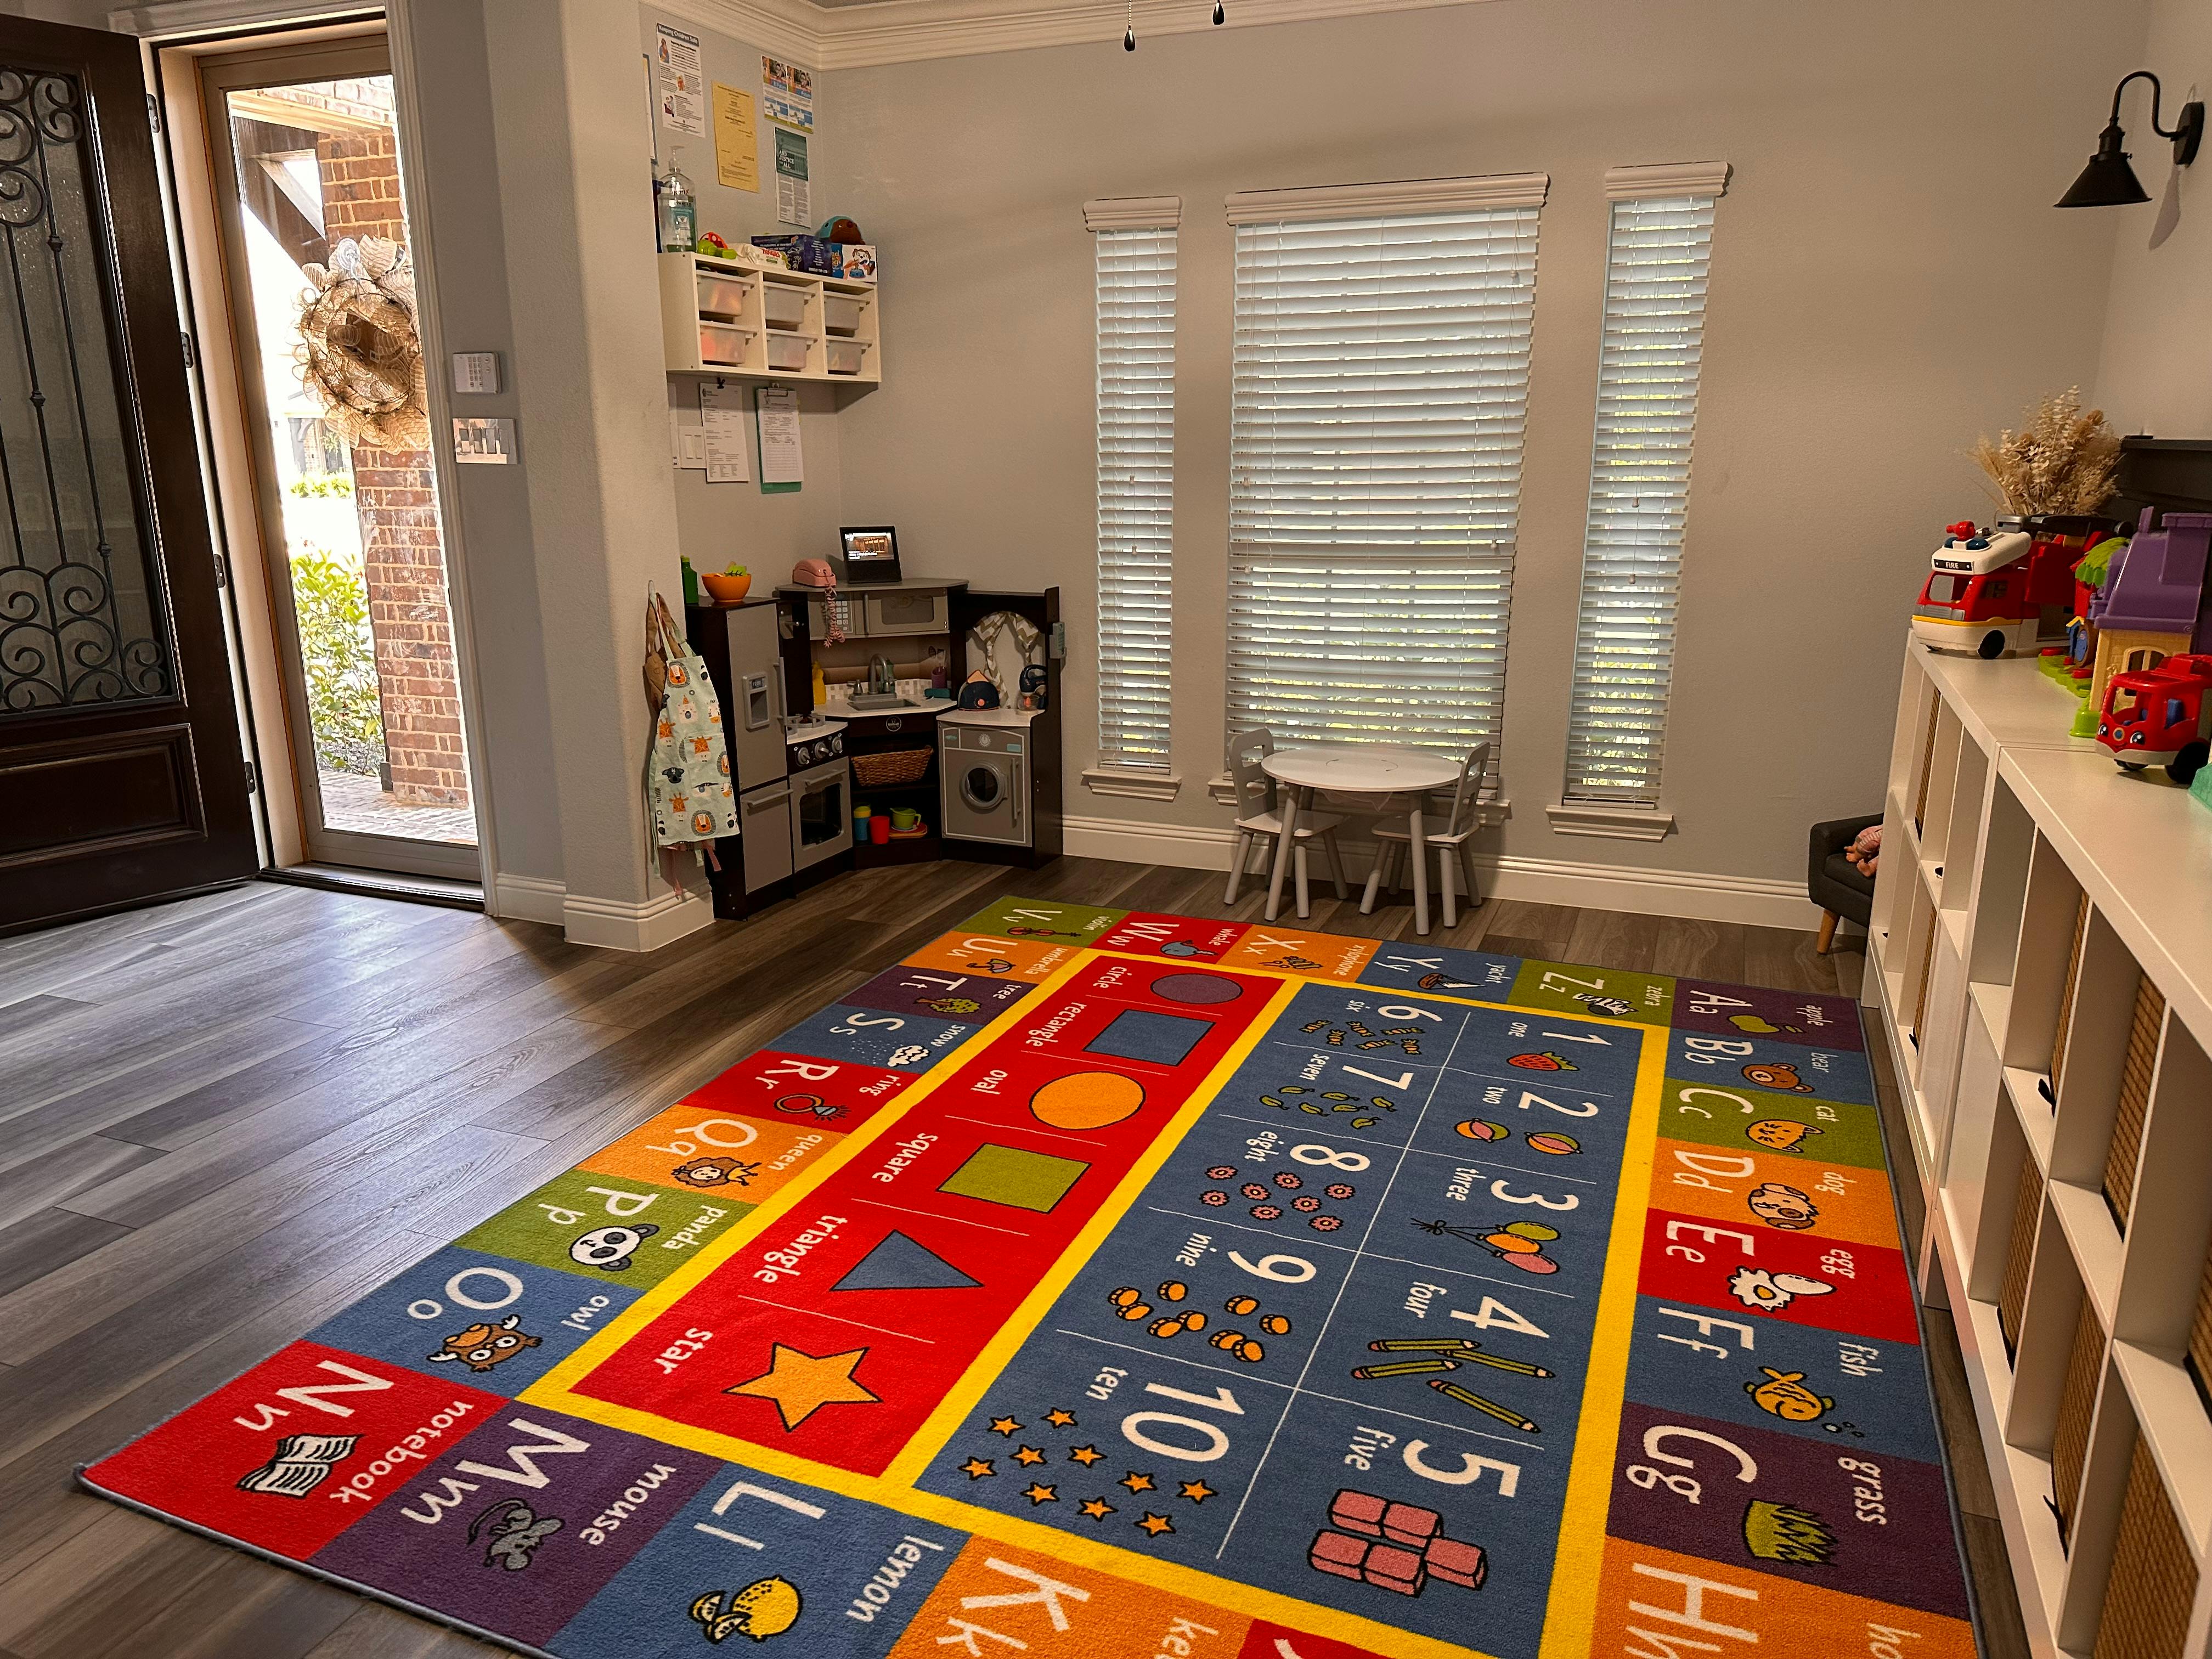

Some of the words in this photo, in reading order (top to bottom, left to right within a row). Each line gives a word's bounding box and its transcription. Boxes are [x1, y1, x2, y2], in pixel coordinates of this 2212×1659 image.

[779, 155, 794, 164] JUSTICE
[1083, 916, 1112, 930] violin
[1207, 927, 1237, 946] whale
[1024, 947, 1068, 974] umbrella
[1333, 944, 1367, 977] xylophone
[1485, 963, 1506, 984] yacht
[992, 984, 1022, 1000] tree
[1093, 966, 1132, 989] circle
[1345, 1000, 1365, 1012] six
[1644, 985, 1663, 1007] zebra
[1025, 1002, 1087, 1047] rectangle
[1378, 1005, 1443, 1022] 6
[1796, 1005, 1833, 1026] apple
[930, 1024, 966, 1047] snow
[1508, 1022, 1528, 1037] one
[1542, 1031, 1612, 1046] 1
[1299, 1054, 1330, 1080] seven
[1342, 1065, 1414, 1090] 7
[1810, 1052, 1838, 1073] bear
[859, 1075, 901, 1096] ring
[970, 1069, 1008, 1095] oval
[1482, 1086, 1508, 1104] two
[1518, 1091, 1599, 1118] 2
[1815, 1105, 1839, 1122] cat
[768, 1134, 823, 1171] queen
[872, 1132, 939, 1183] square
[1244, 1131, 1279, 1162] eight
[1289, 1144, 1371, 1172] 8
[1446, 1167, 1487, 1201] three
[1491, 1180, 1579, 1211] 3
[1814, 1171, 1857, 1196] dog
[661, 1205, 728, 1250] panda
[752, 1215, 849, 1284] triangle
[1175, 1232, 1217, 1267] nine
[1820, 1249, 1855, 1279] egg
[1227, 1250, 1317, 1283] 9
[561, 1295, 610, 1331] owl
[1403, 1281, 1447, 1319] four
[1449, 1296, 1550, 1339] 4
[654, 1328, 713, 1374] star
[1838, 1341, 1883, 1376] fish
[1085, 1367, 1128, 1401] ten
[1121, 1382, 1245, 1463] 10
[330, 1401, 475, 1505] notebook
[1344, 1425, 1397, 1471] five
[1402, 1438, 1521, 1498] 5
[579, 1463, 677, 1545] mouse
[1837, 1457, 1887, 1525] grass
[845, 1535, 945, 1622] lemon
